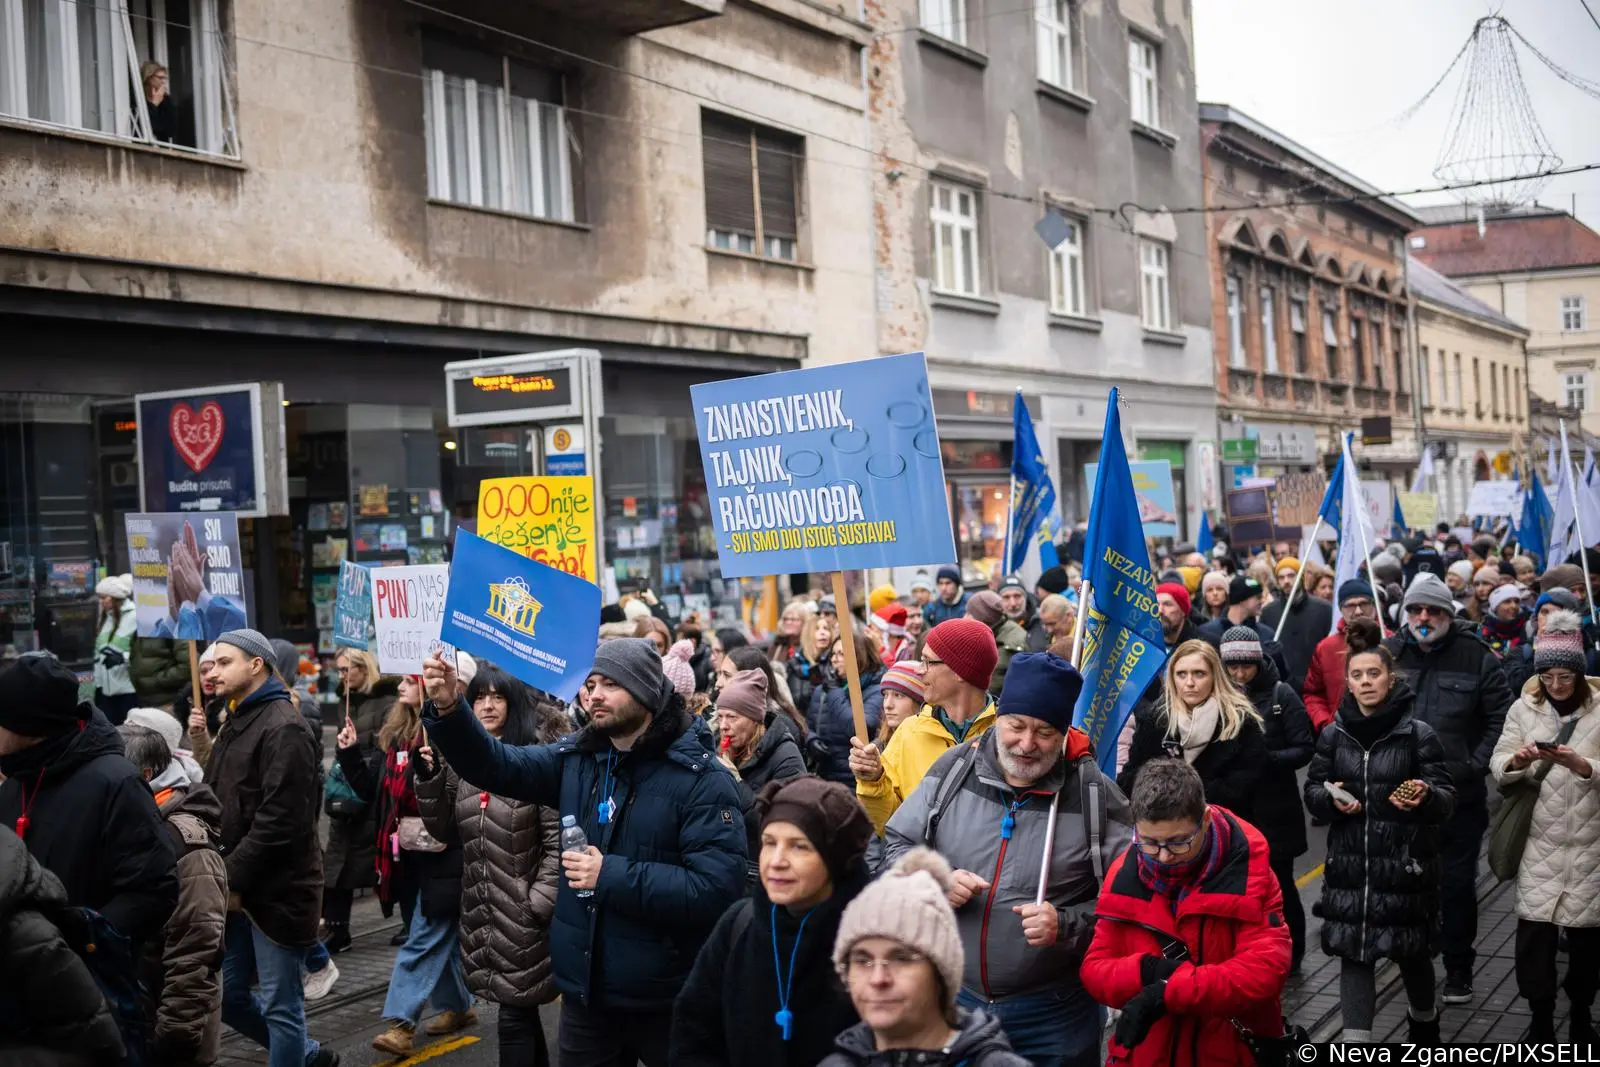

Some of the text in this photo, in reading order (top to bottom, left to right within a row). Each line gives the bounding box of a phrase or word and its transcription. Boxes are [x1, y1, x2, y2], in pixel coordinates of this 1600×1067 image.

[703, 389, 853, 442] ZNANSTVENIK,
[709, 445, 792, 487] TAJNIK,
[168, 480, 198, 493] Budite
[551, 487, 589, 527] nije
[718, 485, 864, 531] RAČUNOVOĐA
[204, 518, 221, 541] SVI
[731, 532, 751, 553] SVI
[753, 529, 779, 551] SMO
[782, 528, 801, 549] DIO
[802, 524, 836, 548] ISTOG
[838, 520, 896, 545] SUSTAVA!
[206, 545, 231, 568] SMO
[210, 572, 240, 595] BITNI!
[376, 579, 418, 619] PUNO
[419, 574, 445, 598] NAS
[1113, 581, 1161, 619] I VISO
[422, 602, 445, 623] IMA
